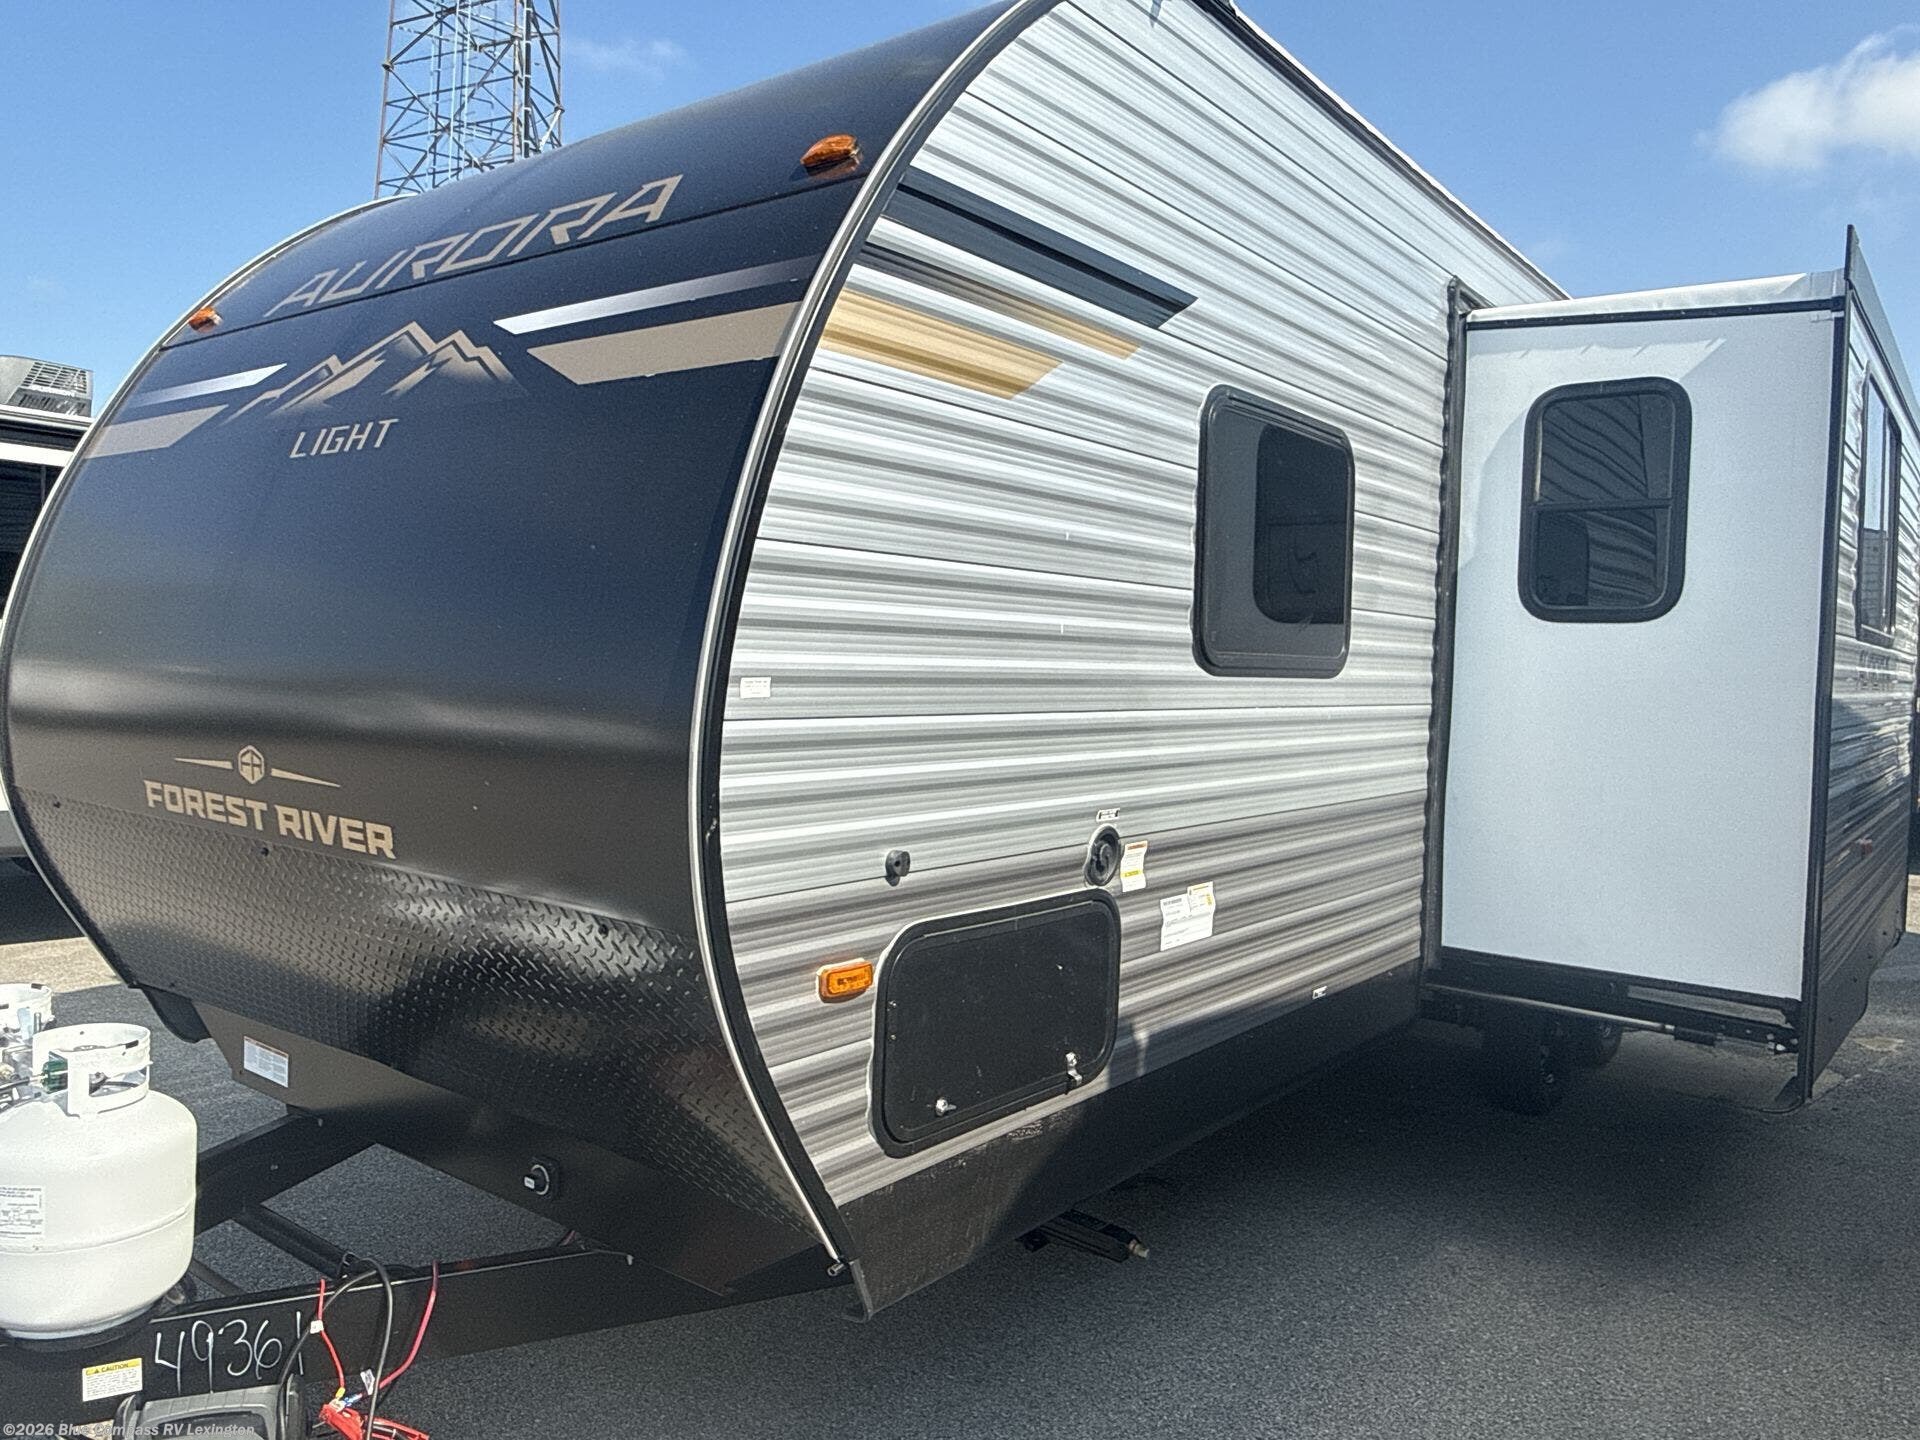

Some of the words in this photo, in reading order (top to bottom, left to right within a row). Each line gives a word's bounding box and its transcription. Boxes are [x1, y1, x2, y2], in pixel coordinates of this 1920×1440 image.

[263, 173, 684, 318] AURORA
[289, 418, 400, 459] LIGHT
[143, 779, 268, 831] FOREST
[274, 804, 397, 860] RIVER
[101, 1362, 129, 1373] CAUTION
[154, 1310, 305, 1395] 49361
